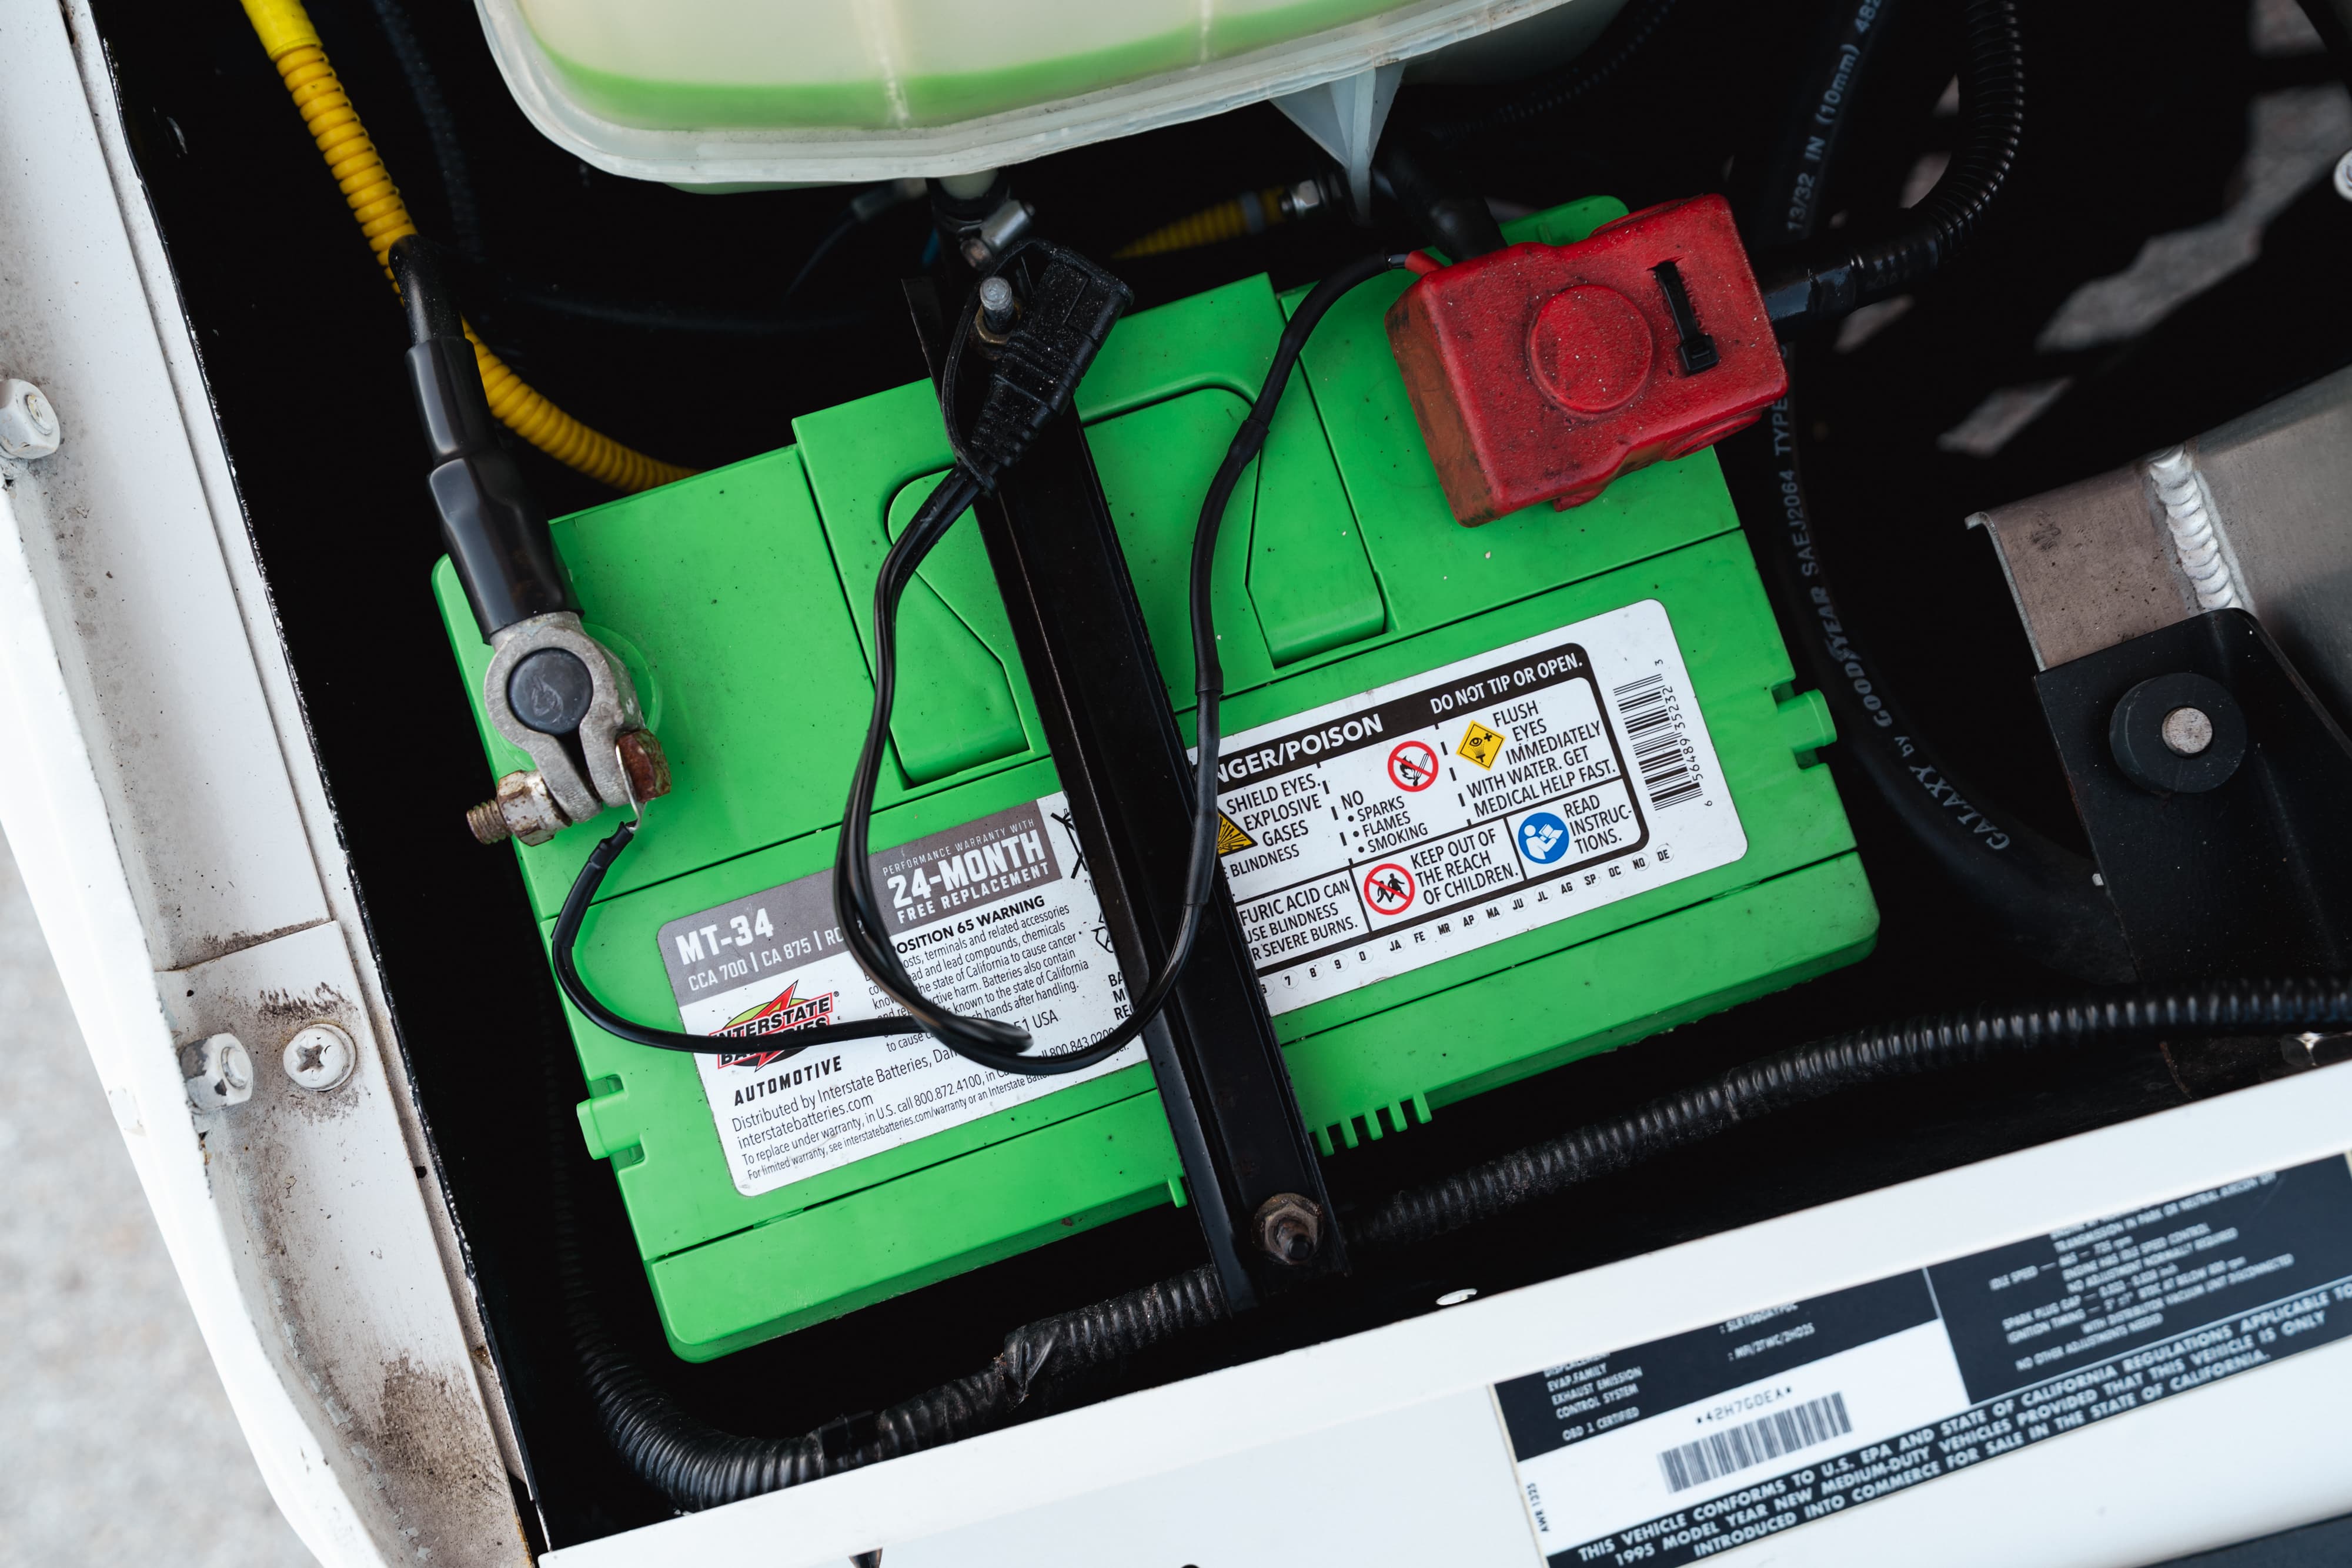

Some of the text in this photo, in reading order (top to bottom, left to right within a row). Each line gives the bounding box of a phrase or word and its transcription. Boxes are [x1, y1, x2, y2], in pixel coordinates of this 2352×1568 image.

[1788, 44, 1860, 231] 13/32 IN (10mm)
[1779, 469, 1819, 577] SAEJ2064
[1429, 652, 1583, 714] DO NOT TIP OR OPEN.
[1492, 700, 1539, 728] FLUSH
[1511, 717, 1547, 742] EYES
[1505, 720, 1601, 765] IMMEDIATELY
[1894, 735, 1915, 757] by
[1225, 773, 1321, 815] SHIELD EYES.
[1465, 744, 1589, 799] WITH WATER. GET
[1473, 758, 1616, 818] MEDICAL HELP FAST.
[1242, 793, 1322, 832] EXPLOSIVE
[1339, 790, 1364, 810] NO
[1357, 795, 1405, 823] SPARKS
[1562, 794, 1601, 819] READ
[1569, 804, 1632, 837] INSTRUC-
[1909, 763, 2011, 851] GALAXY
[881, 818, 1034, 877] PERFORMANCE WARRANTY WITH
[1261, 819, 1309, 847] GASES
[1361, 810, 1411, 838] FLAMES
[1367, 822, 1429, 853] SMOKING
[1573, 827, 1622, 854] TIONS.
[886, 828, 1046, 910] 24-MONTH
[1229, 843, 1300, 878] BLINDNESS
[1409, 827, 1496, 870] KEEP OUT OF
[1414, 849, 1492, 888] THE REACH
[896, 861, 1048, 924] FREE REPLACEMENT
[1286, 887, 1321, 912] ACID
[1323, 878, 1351, 898] CAN
[1422, 862, 1519, 905] OF CHILDREN.
[674, 907, 774, 965] MT-34
[924, 904, 1070, 961] terminals and related accessories
[957, 895, 1045, 934] 65 WARNING
[1260, 915, 1358, 958] SEVERE BURNS.
[1268, 901, 1339, 937] BLINDNESS
[1284, 848, 1670, 986] 7 8 9 JA FE MR AP MA JU JL AG SP OC NO DE
[687, 937, 812, 991] CCA 700 CA 875
[924, 920, 1066, 977] and lead compounds, chemicals
[931, 932, 1077, 990] state of California to cause cancer
[953, 948, 1076, 998] harm. Batteries also contain
[731, 1096, 799, 1132] Distributed
[799, 1094, 816, 1111] by
[817, 1075, 875, 1103] Interstate
[874, 1056, 932, 1084] Batteries,
[1031, 1009, 1059, 1029] USA
[734, 1054, 842, 1106] AUTOMOTIVE
[737, 1094, 874, 1149] interstatebatteries.com
[741, 1152, 755, 1166] To
[755, 1142, 790, 1162] replace
[790, 1131, 820, 1149] under
[820, 1117, 865, 1139] warranty,
[864, 1112, 876, 1124] in
[875, 1104, 897, 1120] U.S.
[897, 1096, 914, 1113] call
[913, 1073, 985, 1107] 800.872.4100,
[984, 1067, 996, 1082] in
[1555, 1396, 1601, 1419] CONTROL
[1577, 1291, 2329, 1562] THIS VEHICLE CONFORMS TO U.S. EPA AND STATE OF CALIFORNIA REGULATIONS APPLICABLE
[1614, 1310, 2324, 1566] 1995 MODEL YEAR NEW MEDIUM-DUTY VEHICLES PROVIDED THAT THIS VEHICLE ONLY
[1693, 1349, 2270, 1557] INTRODUCED INTO COMMERCE FOR SALE IN THE STATE OF CALIFORNIA.
